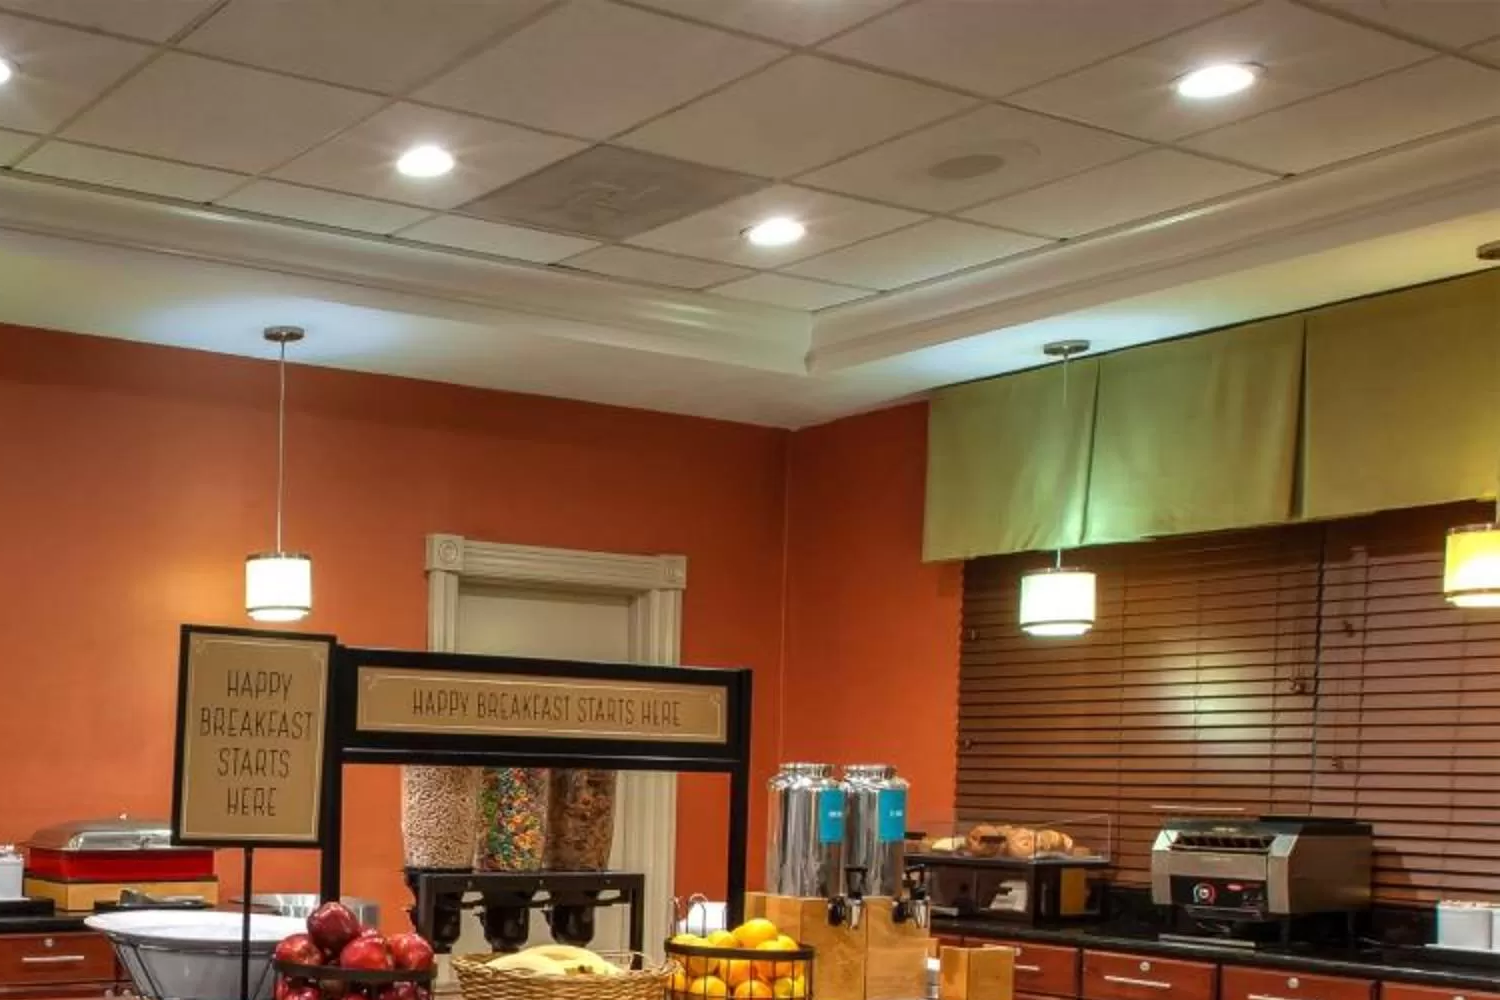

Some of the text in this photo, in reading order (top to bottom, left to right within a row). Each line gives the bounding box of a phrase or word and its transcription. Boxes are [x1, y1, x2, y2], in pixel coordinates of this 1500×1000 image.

[227, 670, 292, 700] HAPPY
[412, 688, 681, 727] HAPPY BREAKFAST STARTS HERE
[200, 707, 313, 740] BREAKFAST
[217, 747, 291, 778] STARTS
[227, 786, 277, 816] HERE
